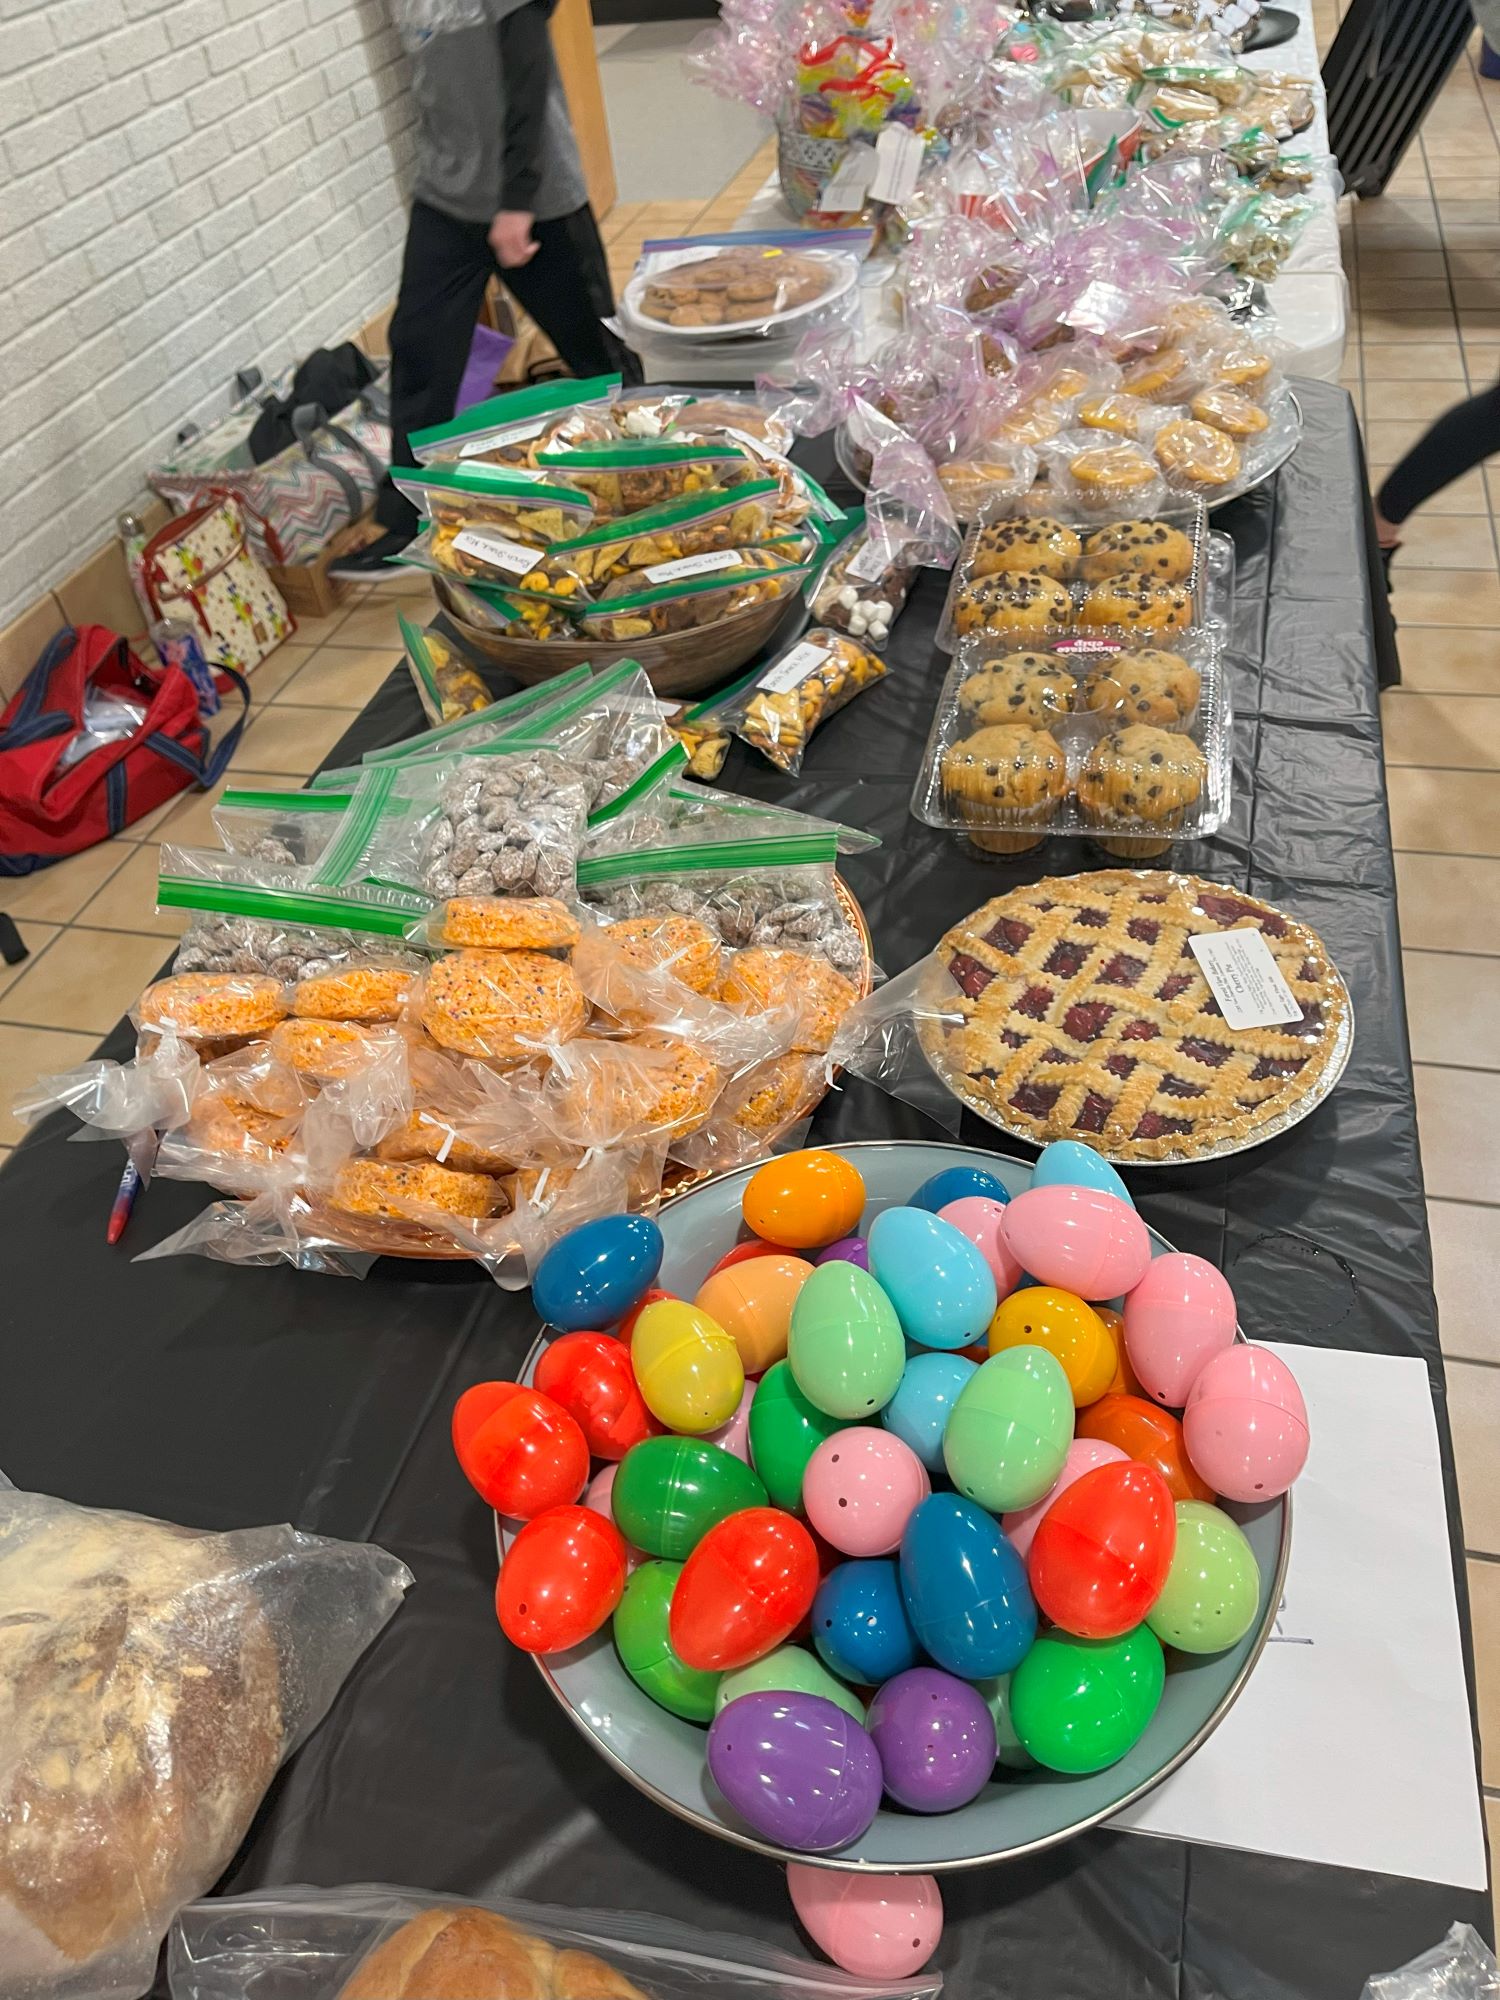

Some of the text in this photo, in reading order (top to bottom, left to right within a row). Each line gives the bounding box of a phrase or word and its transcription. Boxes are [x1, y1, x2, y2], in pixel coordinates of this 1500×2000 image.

[1073, 640, 1104, 648] chip
[1225, 963, 1244, 993] Cherry Pie
